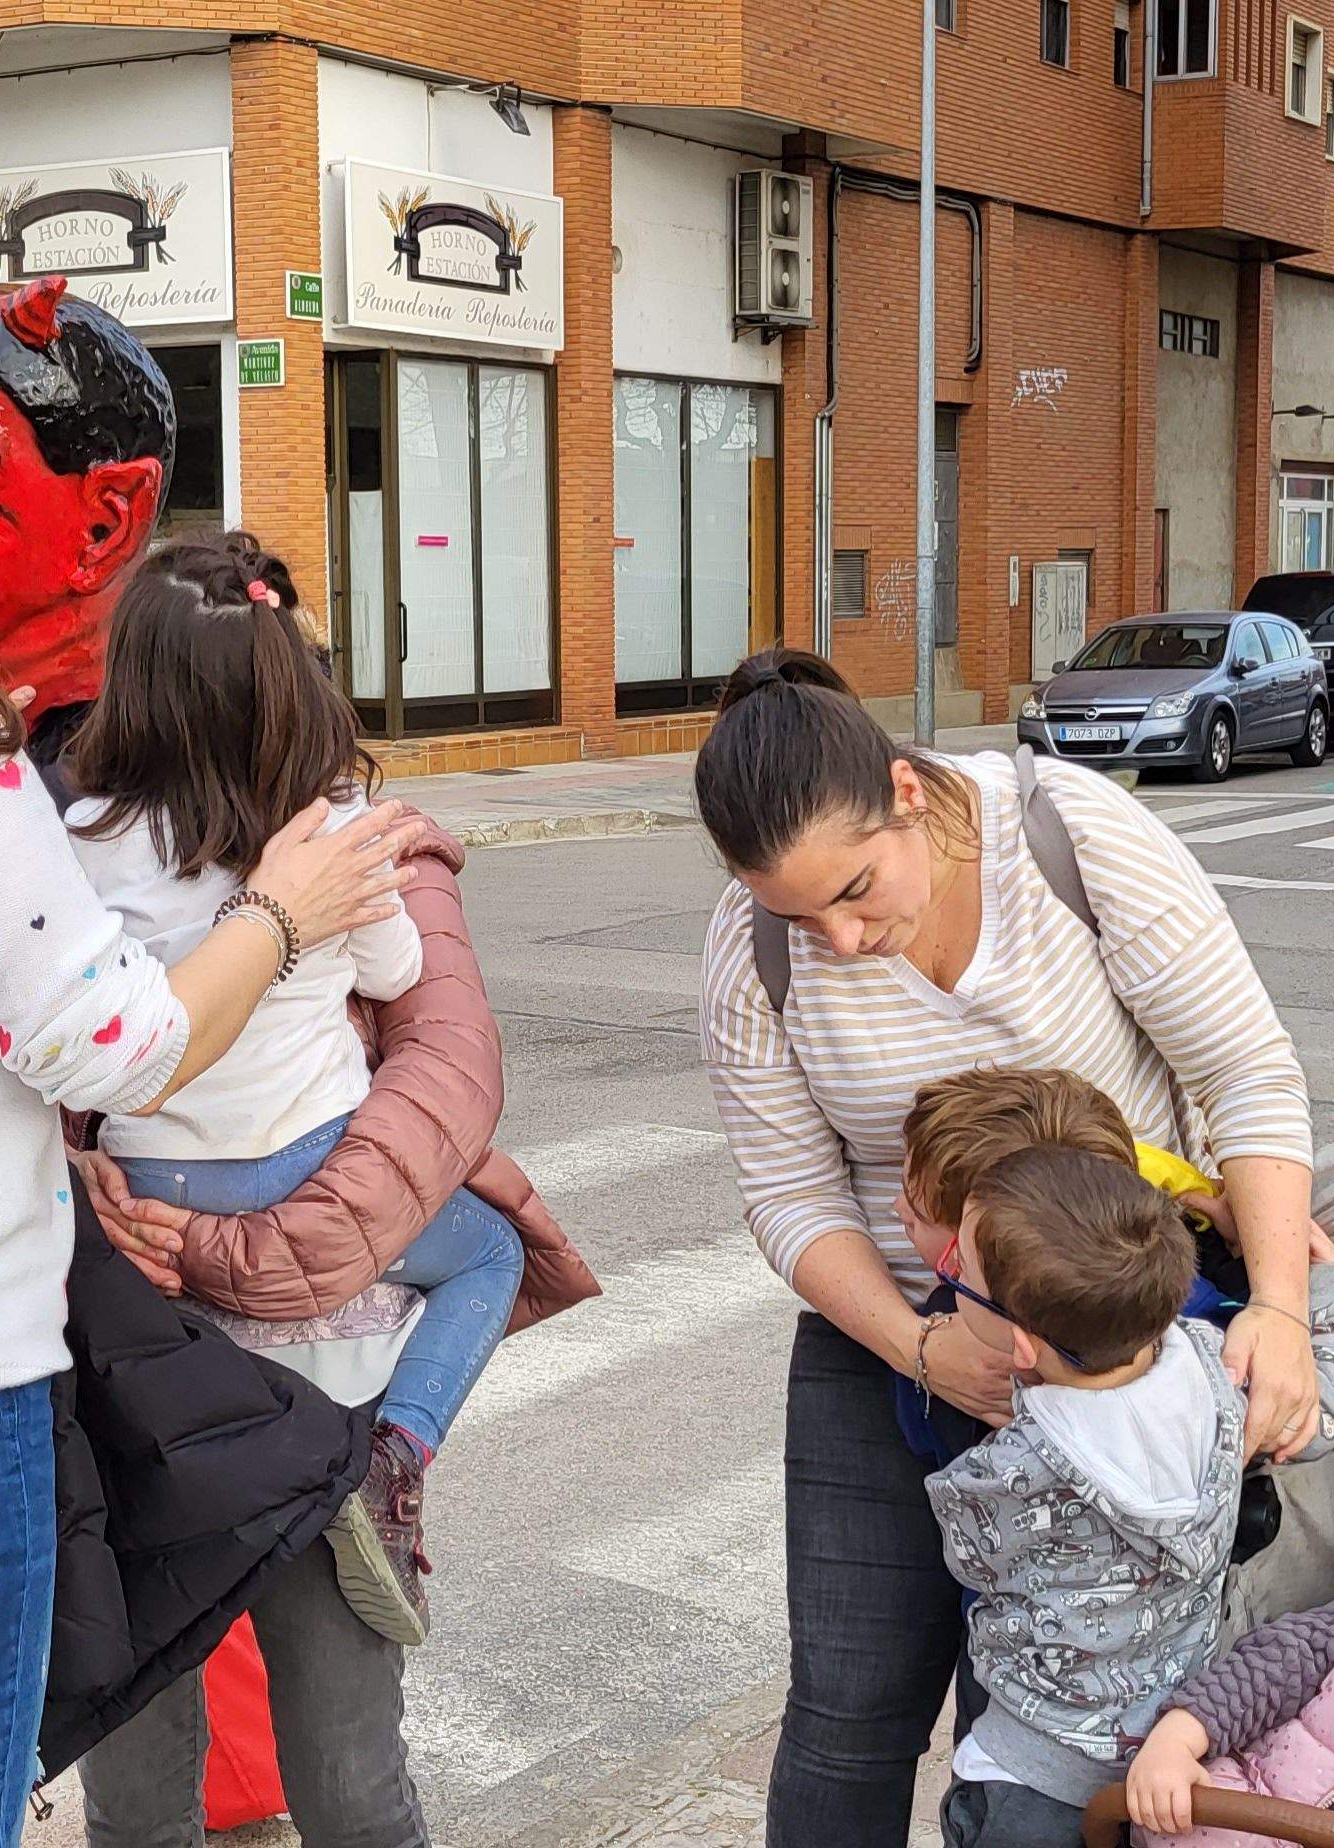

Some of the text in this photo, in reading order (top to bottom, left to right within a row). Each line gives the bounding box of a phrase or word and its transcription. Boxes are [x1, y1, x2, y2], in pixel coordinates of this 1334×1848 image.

[37, 217, 114, 243] HORNO
[430, 230, 487, 257] HORNO
[32, 241, 120, 269] ESTACIÓN
[425, 256, 490, 282] ESTACIÓN
[88, 279, 222, 320] Repostería
[356, 281, 557, 336] Panadería Repostería
[1068, 728, 1093, 739] 7073
